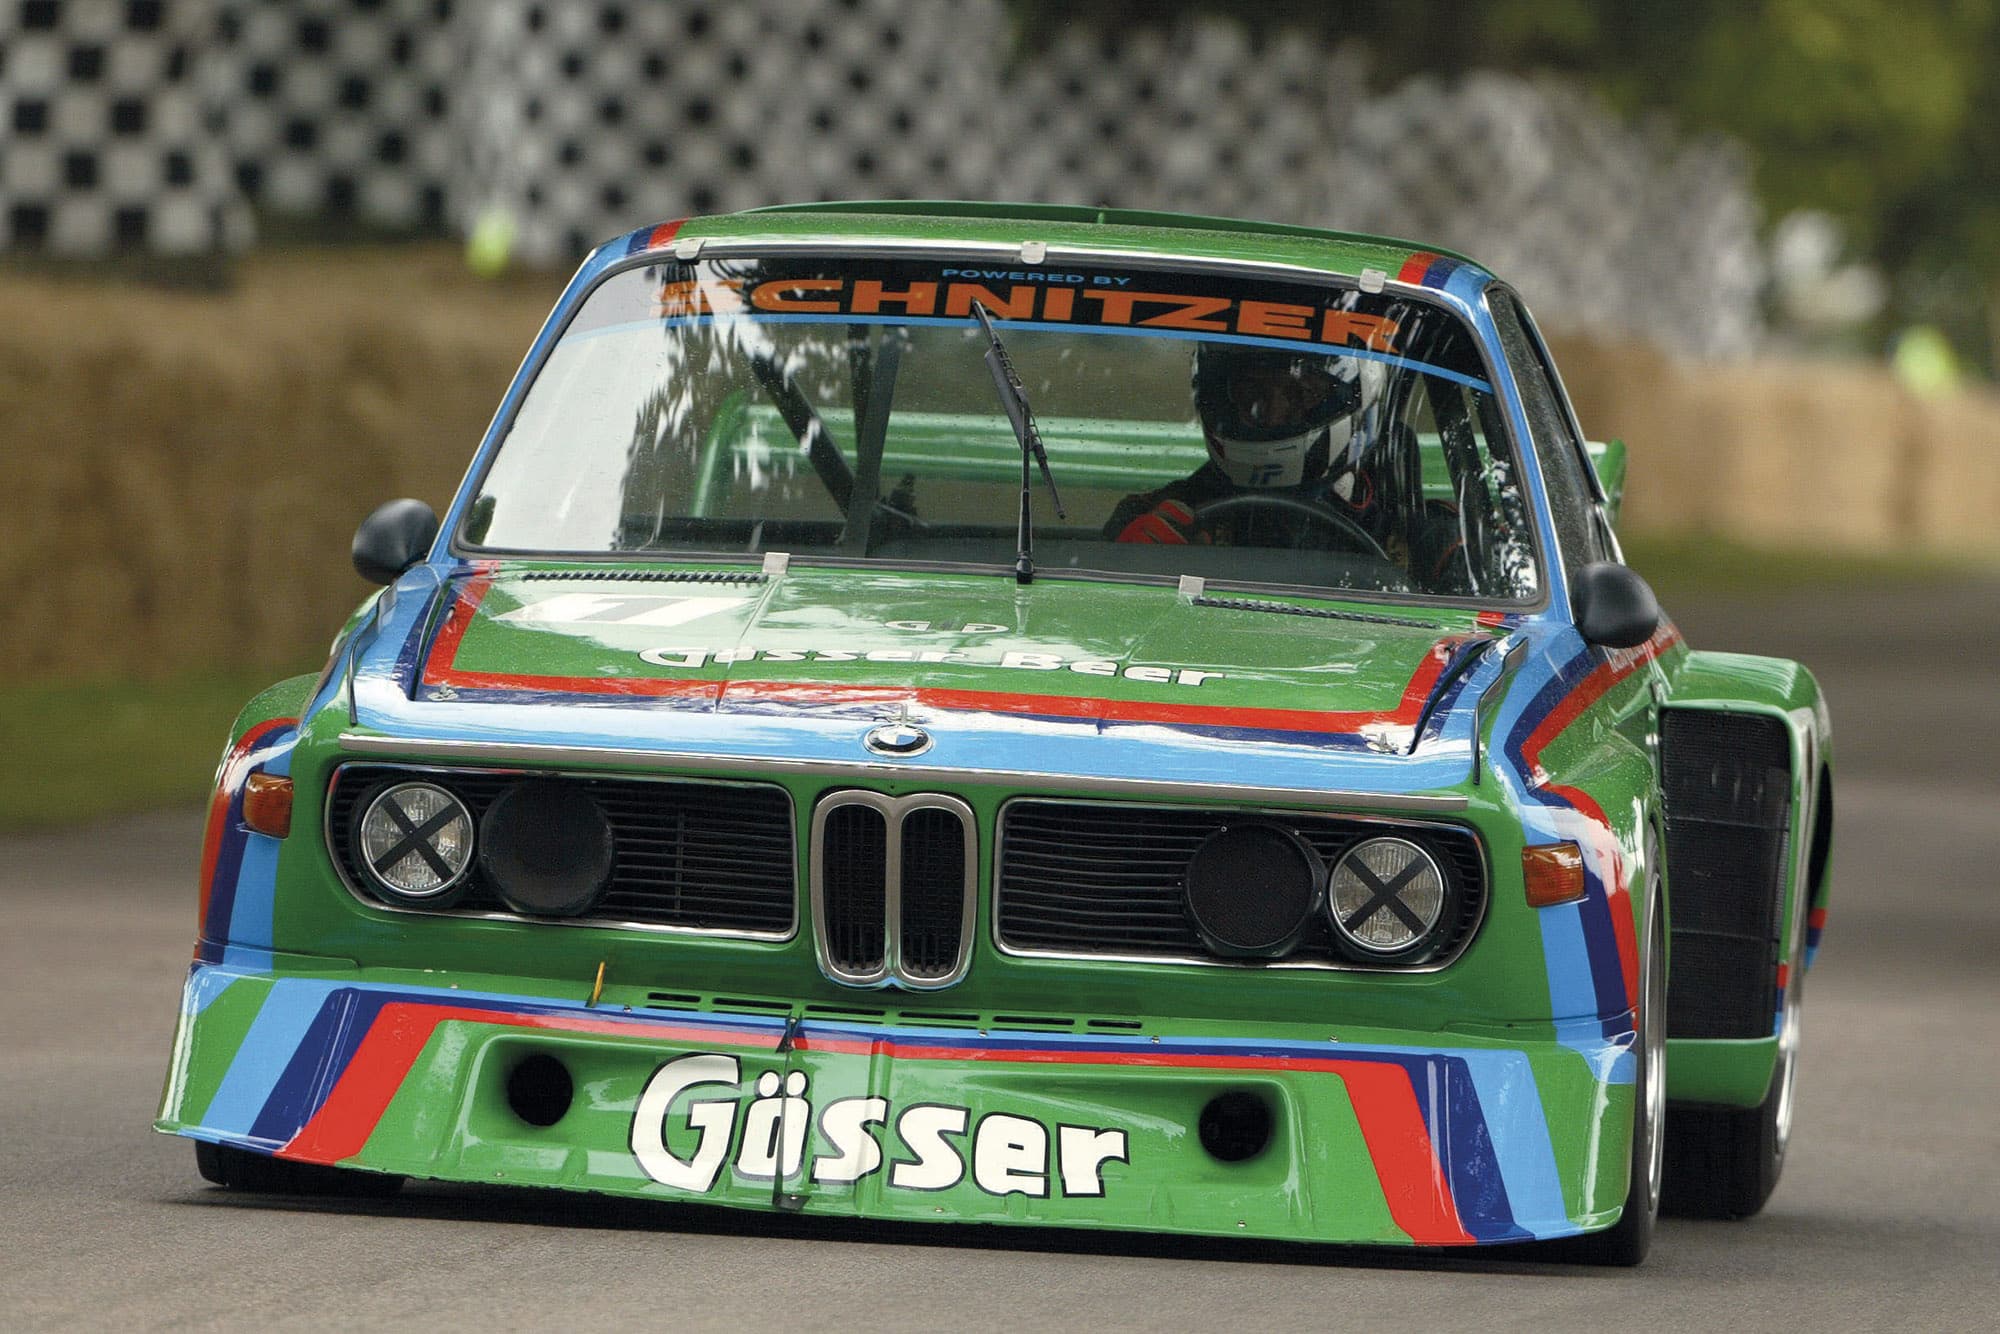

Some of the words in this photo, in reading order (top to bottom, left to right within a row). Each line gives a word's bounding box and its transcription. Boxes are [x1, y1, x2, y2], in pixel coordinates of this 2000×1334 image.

[942, 268, 1084, 283] POWERED
[1093, 276, 1130, 286] BY
[1001, 651, 1226, 686] Beer
[628, 1052, 1129, 1198] Gösser
